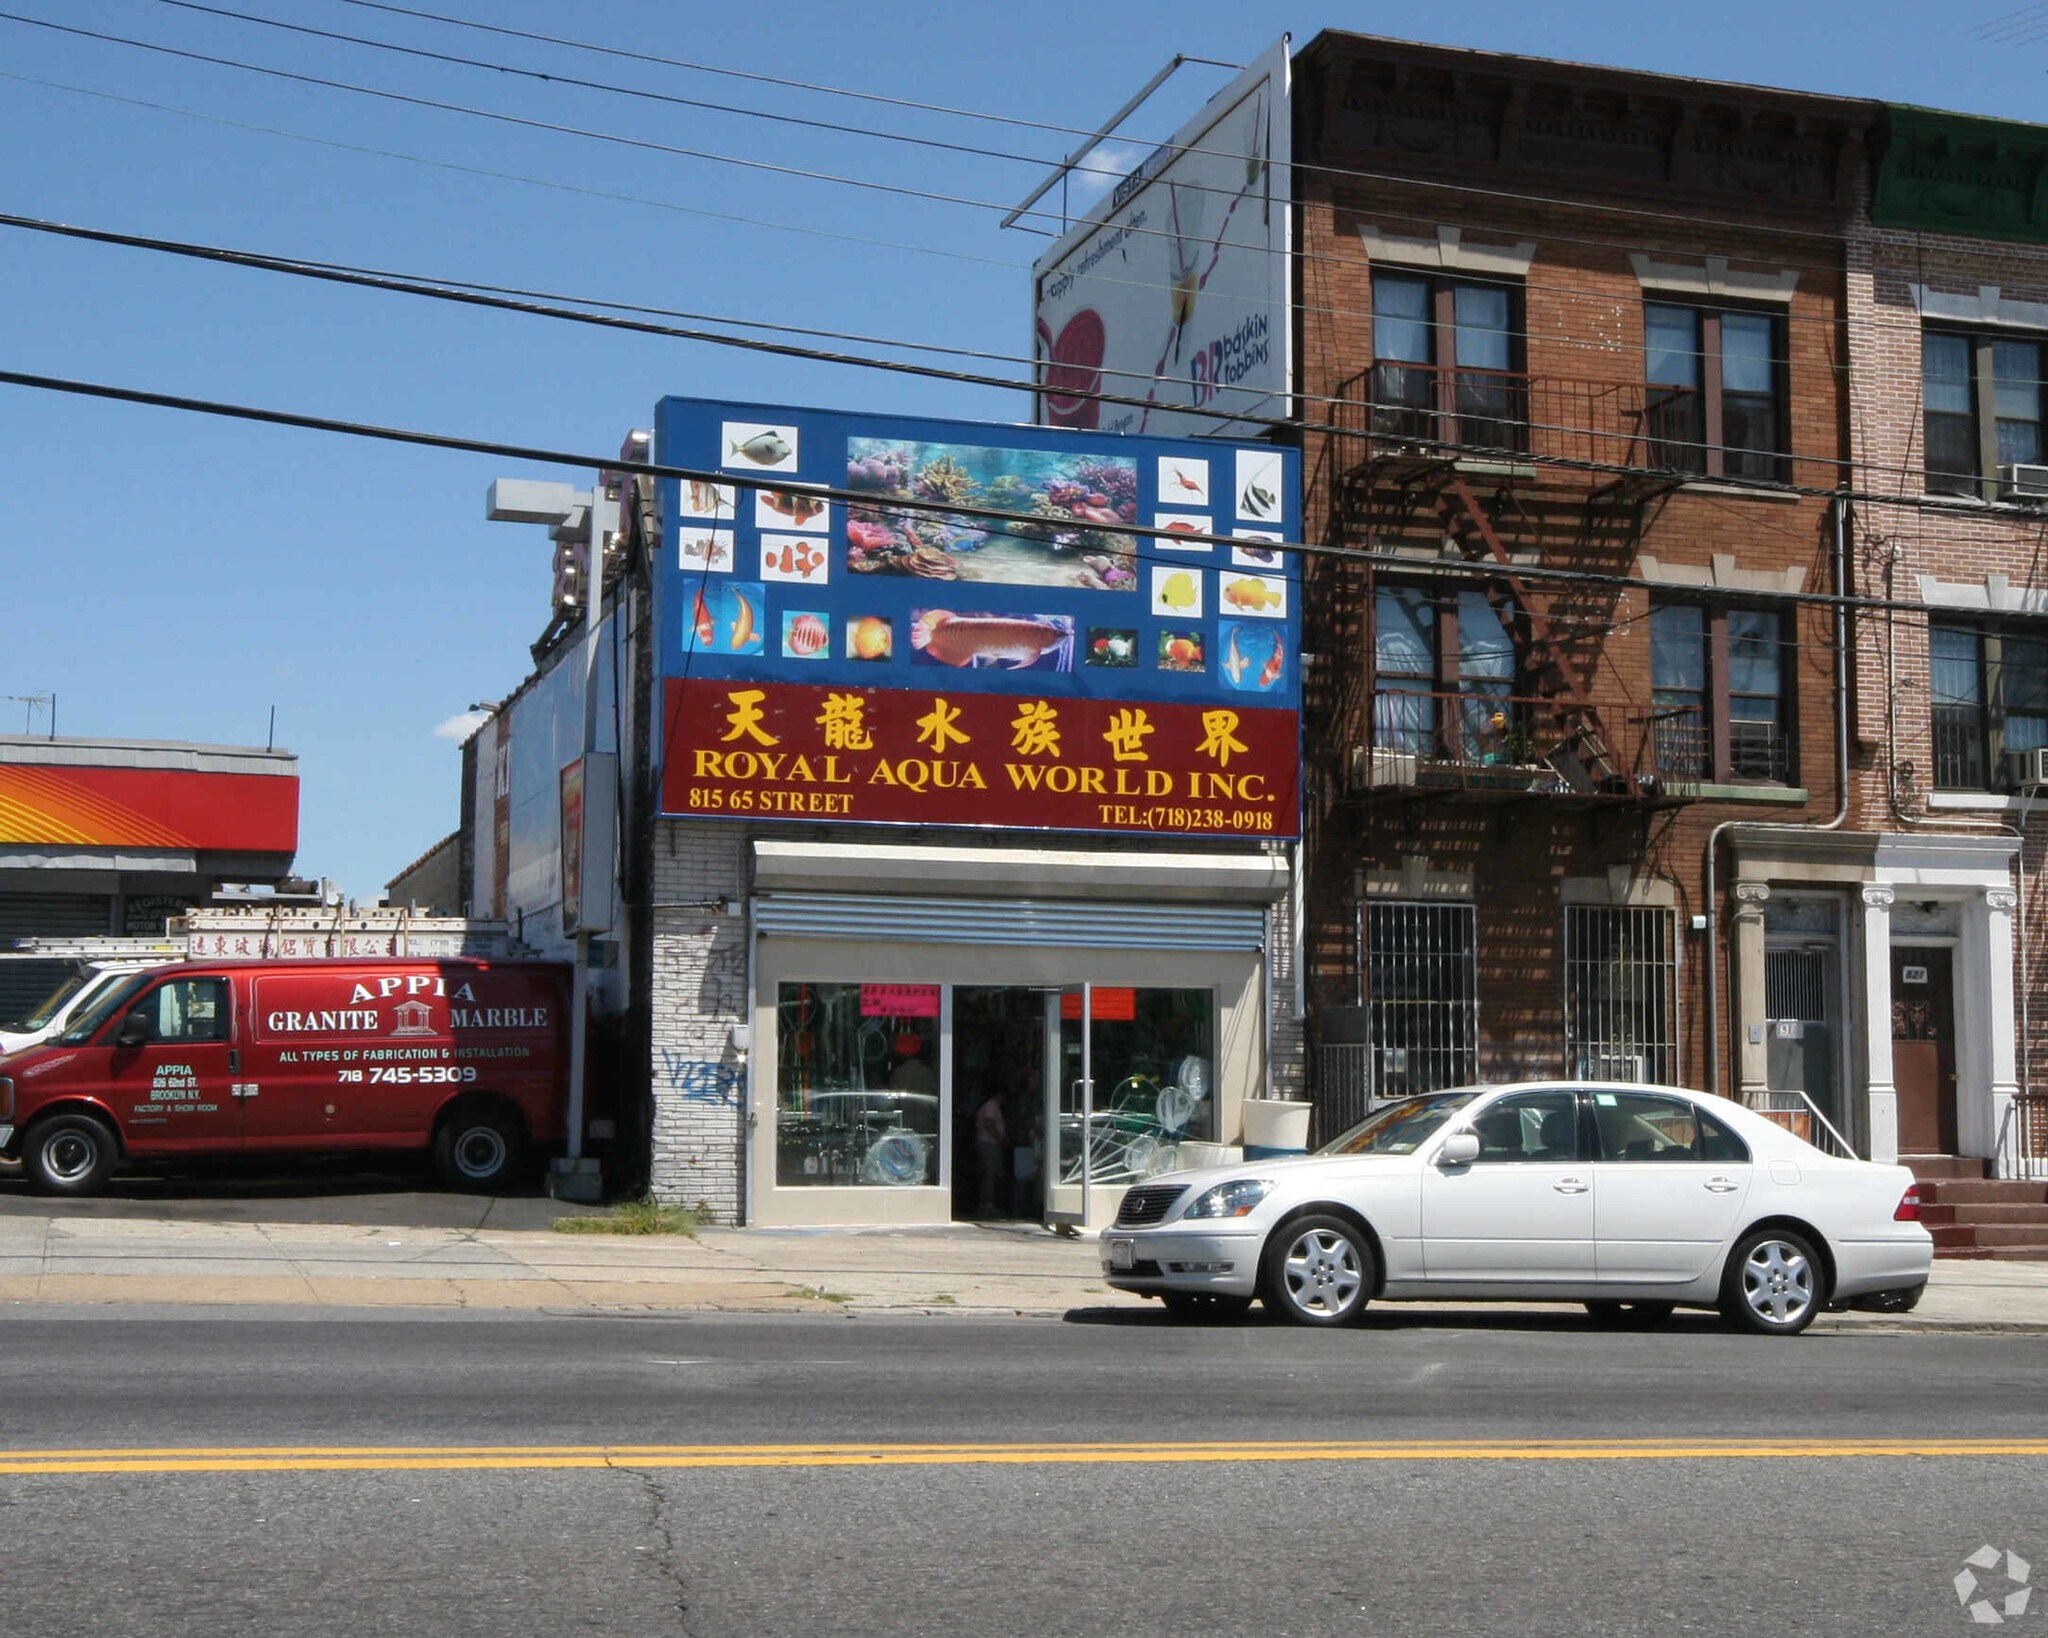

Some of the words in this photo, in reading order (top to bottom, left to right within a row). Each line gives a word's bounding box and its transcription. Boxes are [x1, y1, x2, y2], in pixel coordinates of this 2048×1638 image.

[720, 689, 1249, 767] 天龍水族世界
[692, 750, 851, 783] ROYAL
[867, 758, 988, 793] AQUA
[1005, 763, 1174, 797] WORLD
[1187, 771, 1276, 802] INC.
[689, 788, 723, 809] 815
[729, 789, 753, 810] 65
[759, 790, 854, 813] STREET
[349, 975, 477, 1004] APPIA
[268, 1011, 378, 1031] GRANITE
[449, 1008, 548, 1028] MARBLE
[279, 1051, 298, 1062] ALL
[302, 1050, 339, 1061] TYPES
[343, 1050, 358, 1061] OF
[363, 1048, 438, 1060] FABRICATION
[442, 1049, 449, 1059] &
[454, 1047, 530, 1058] INSTALLATION
[155, 1065, 192, 1075] APPIA
[338, 1070, 363, 1082] 718
[369, 1066, 476, 1084] 745-5309
